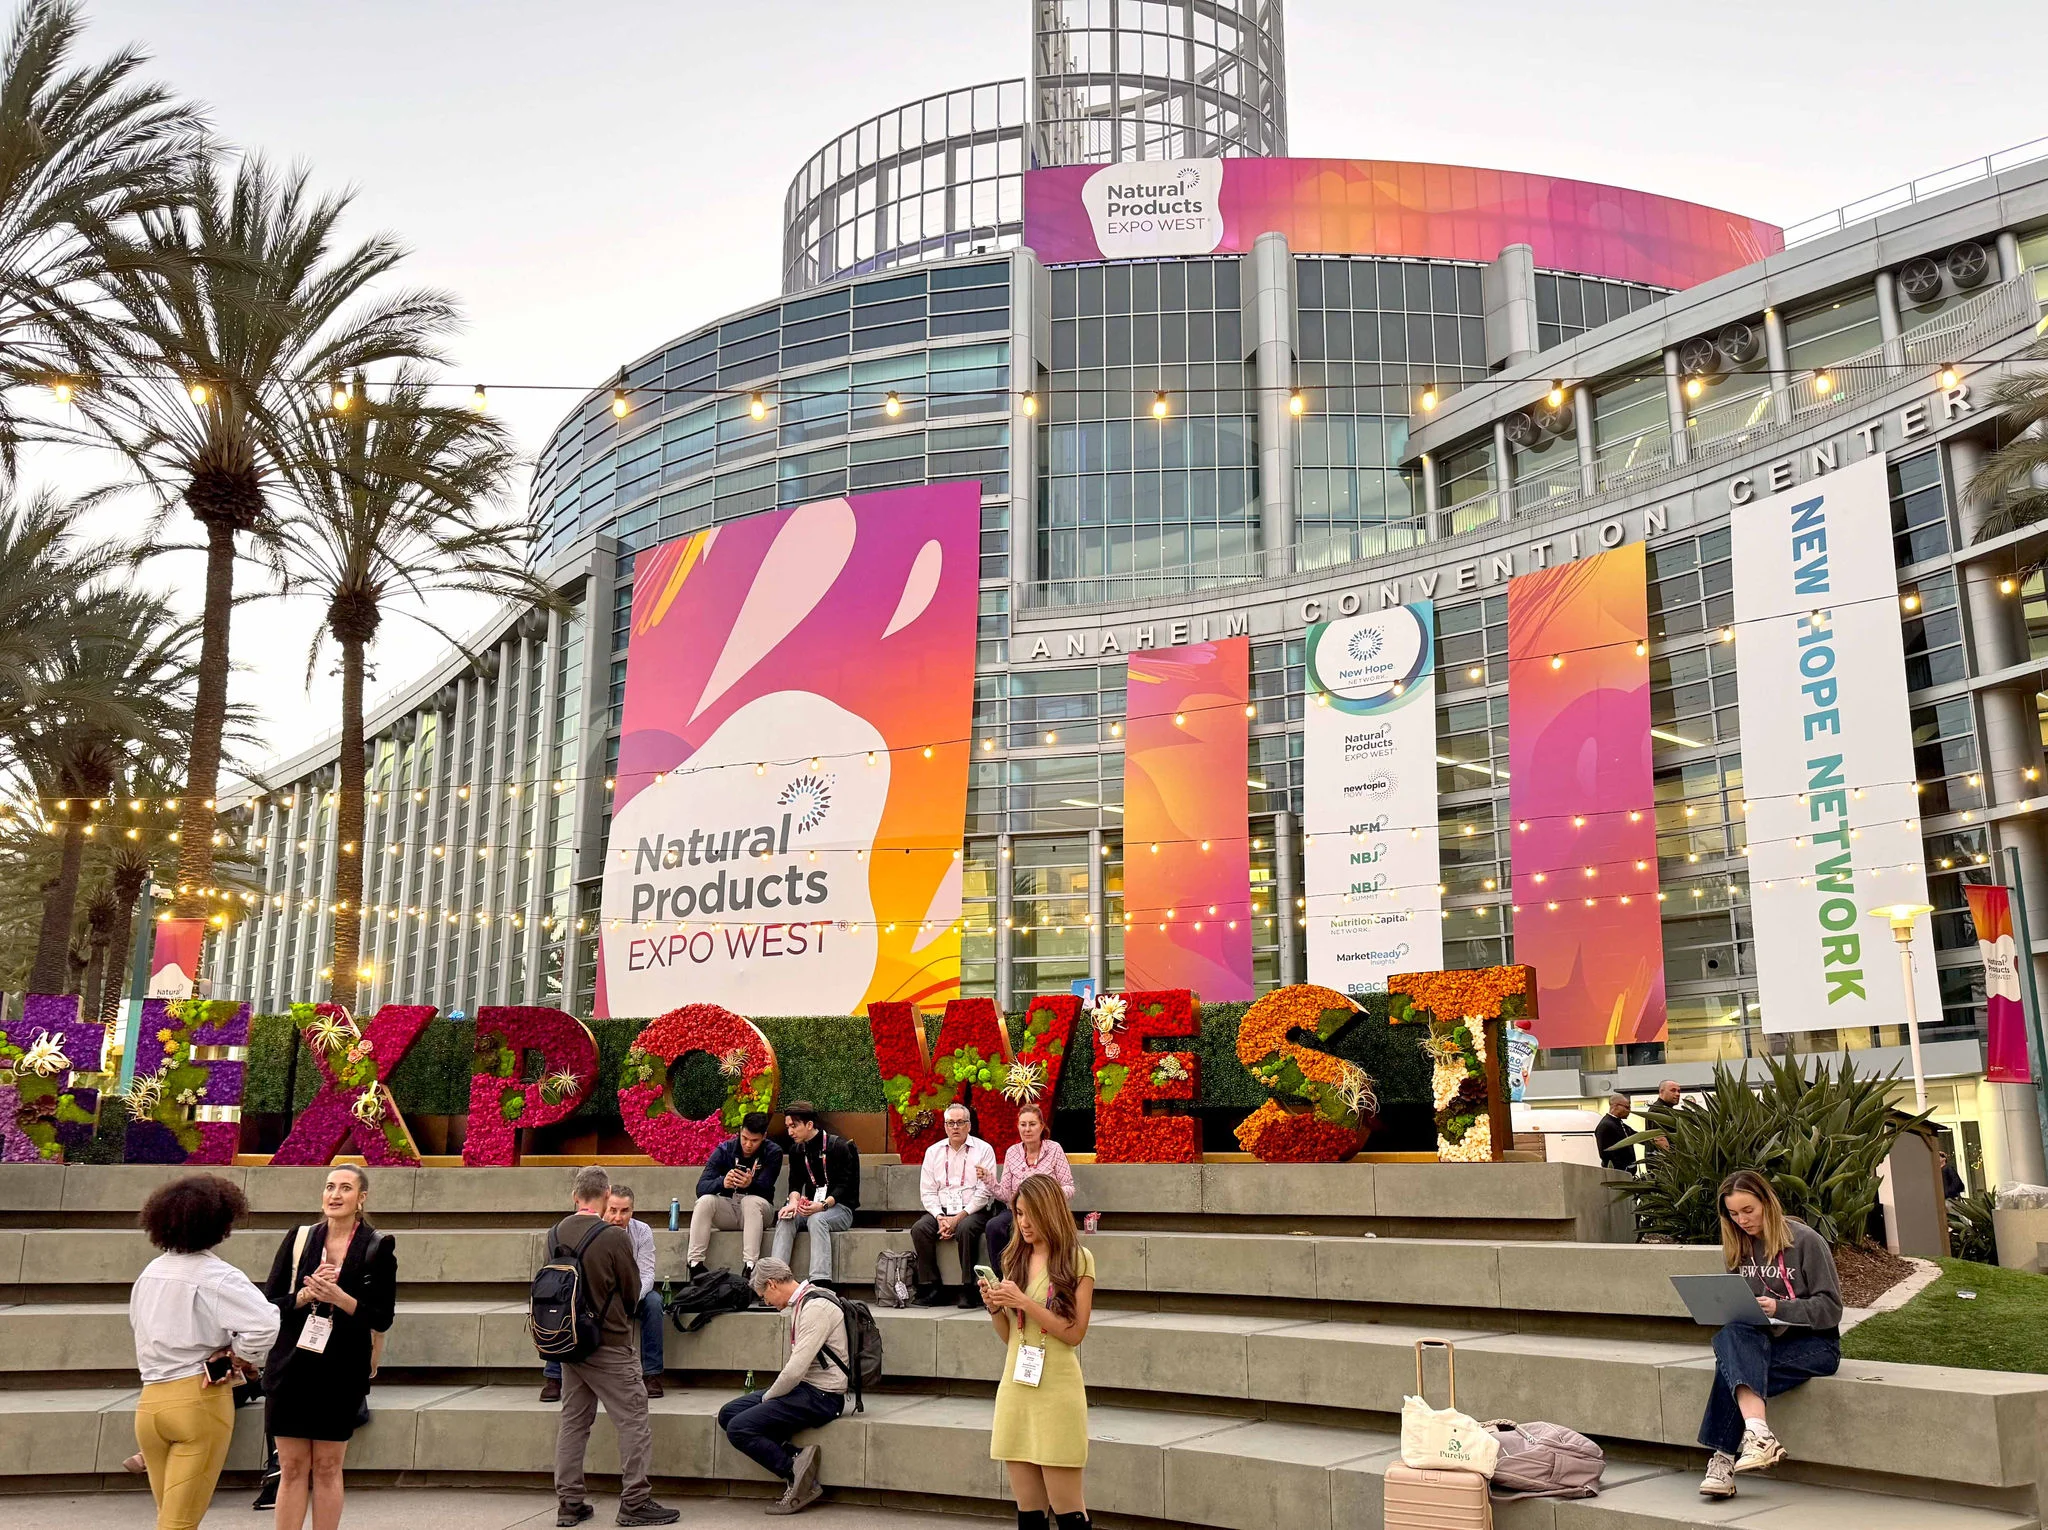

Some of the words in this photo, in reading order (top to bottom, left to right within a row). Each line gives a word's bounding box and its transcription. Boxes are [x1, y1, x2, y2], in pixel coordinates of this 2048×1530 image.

[1107, 181, 1184, 200] Natural
[1107, 199, 1202, 217] Products
[1107, 219, 1153, 234] EXPO
[1157, 217, 1205, 231] WEST
[1031, 613, 1250, 659] ANAHEIM
[1300, 504, 1669, 623] CONVENTION
[1728, 382, 1974, 505] CENTER
[1791, 495, 1830, 595] NEW
[1339, 668, 1363, 679] New
[1365, 663, 1394, 673] Hope
[1348, 674, 1385, 684] NETWORK
[1797, 610, 1841, 741] HOPE
[1345, 730, 1384, 744] Natural
[1345, 739, 1393, 753] Products
[1345, 751, 1369, 761] EXPO
[1370, 748, 1394, 758] WEST
[1343, 780, 1386, 792] newtopia
[1350, 822, 1380, 835] NFM
[634, 813, 792, 875] Natural
[1350, 851, 1379, 864] NBJ
[1351, 881, 1379, 893] NBJ
[1806, 753, 1867, 1005] NETWORK
[631, 865, 829, 924] Products
[1351, 893, 1379, 902] SUMMIT
[628, 931, 714, 971] EXPO
[1336, 950, 1401, 962] MarketReady
[868, 963, 1538, 1165] WEST
